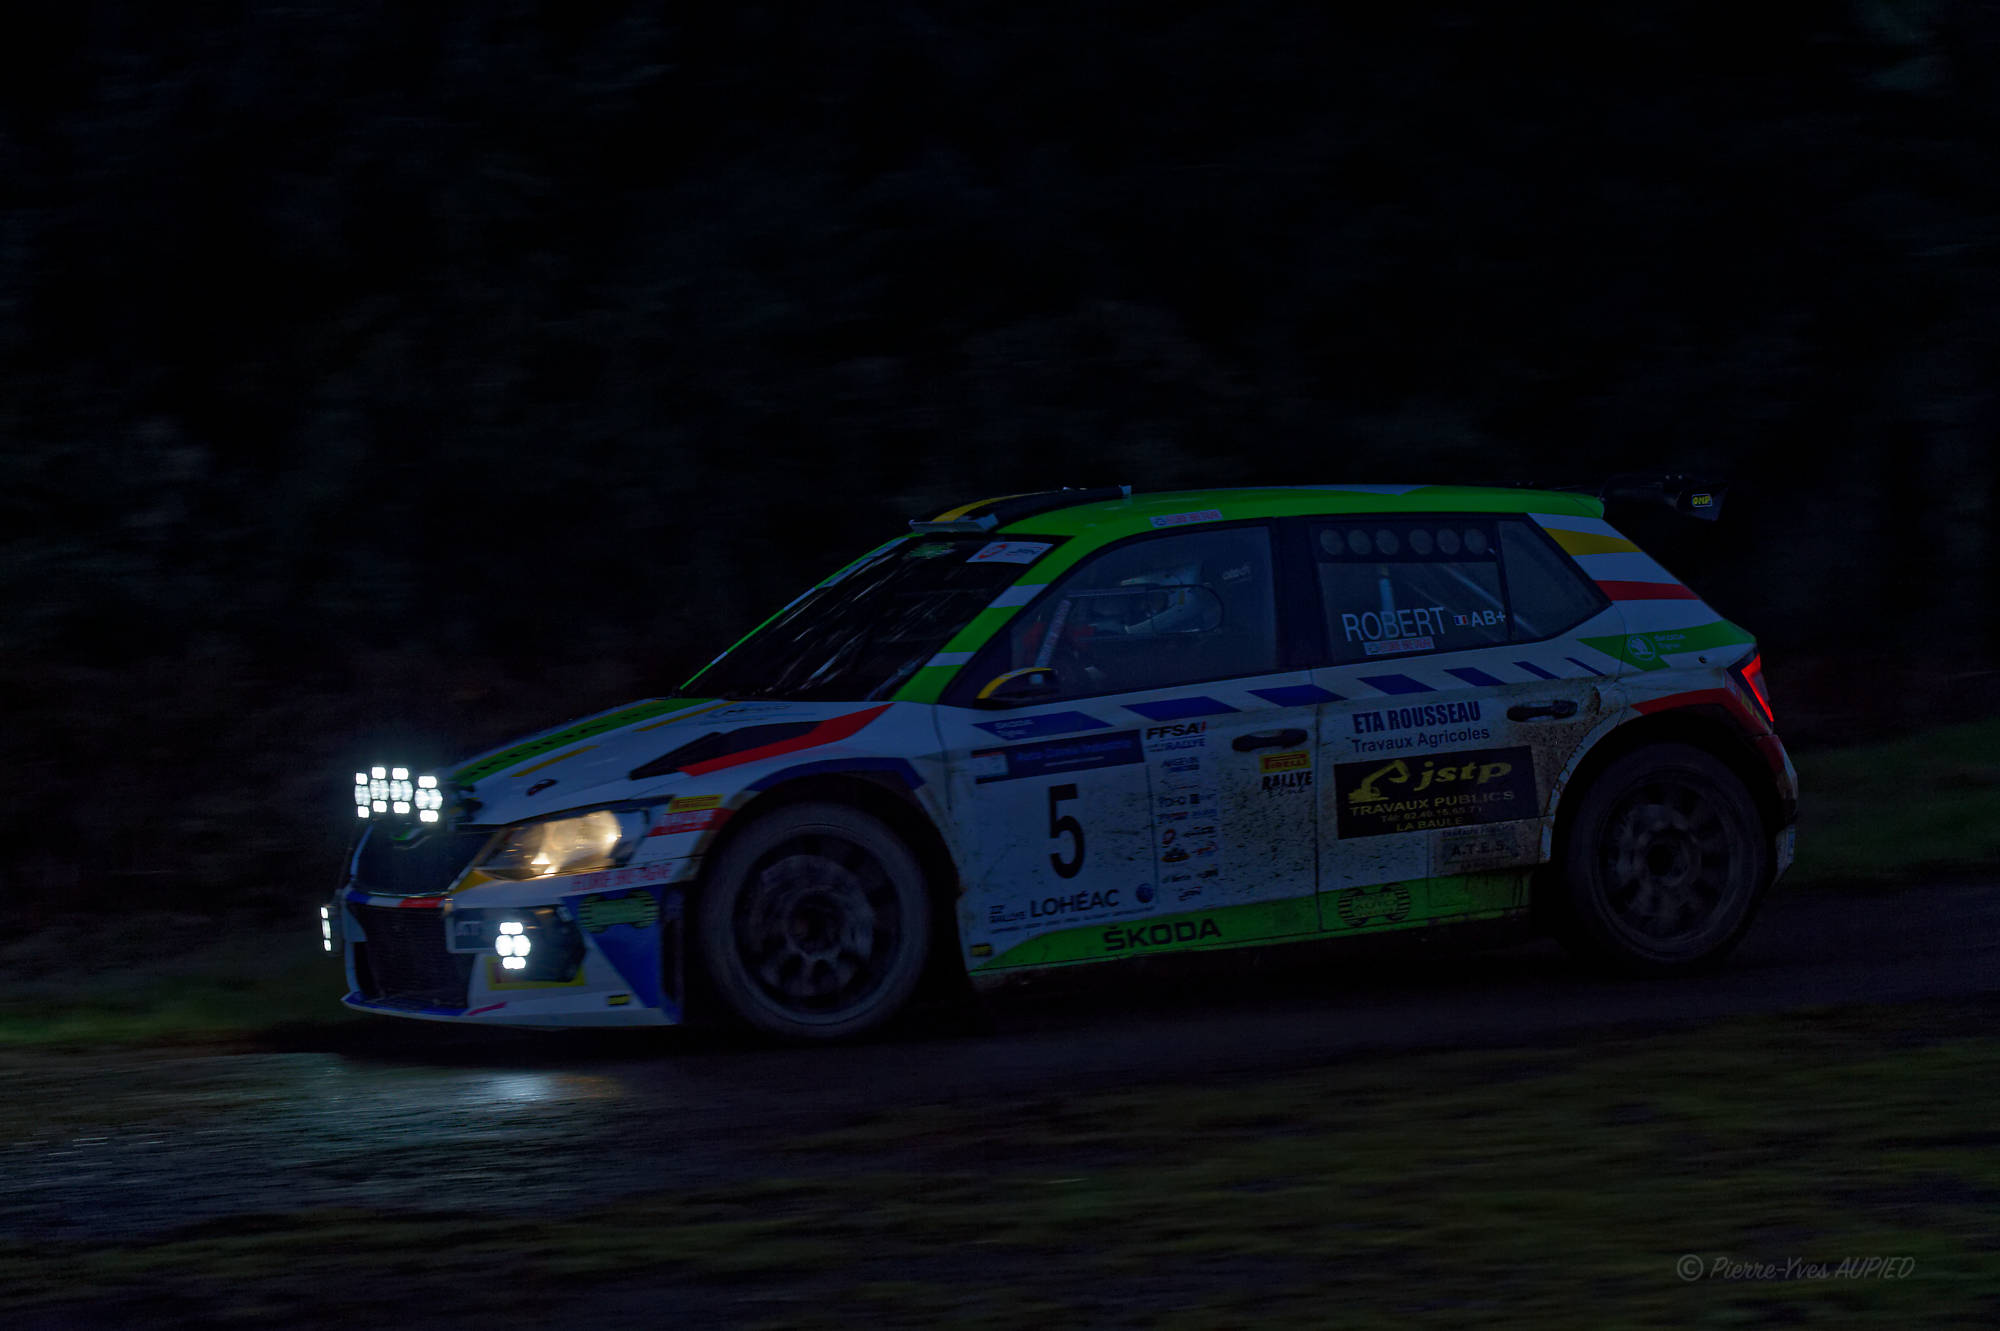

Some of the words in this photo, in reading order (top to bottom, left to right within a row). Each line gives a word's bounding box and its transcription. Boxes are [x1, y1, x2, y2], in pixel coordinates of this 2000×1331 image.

[1341, 607, 1444, 642] ROBERT
[1470, 611, 1505, 627] AB+
[1146, 723, 1200, 740] FFSA
[1352, 710, 1384, 734] ETA
[1387, 701, 1481, 730] ROUSSEAU
[1351, 737, 1413, 753] Travaux
[1418, 727, 1490, 749] Agricoles
[1262, 771, 1312, 790] RALLYE
[1413, 761, 1513, 792] jstp
[1349, 799, 1430, 817] TRAVAUX
[1434, 790, 1515, 809] PUBLICS
[1048, 784, 1085, 879] 5
[1396, 821, 1416, 833] LA
[1418, 817, 1464, 831] BAULE
[1030, 889, 1120, 919] LOHÉAC
[1103, 919, 1222, 951] ŠKODA
